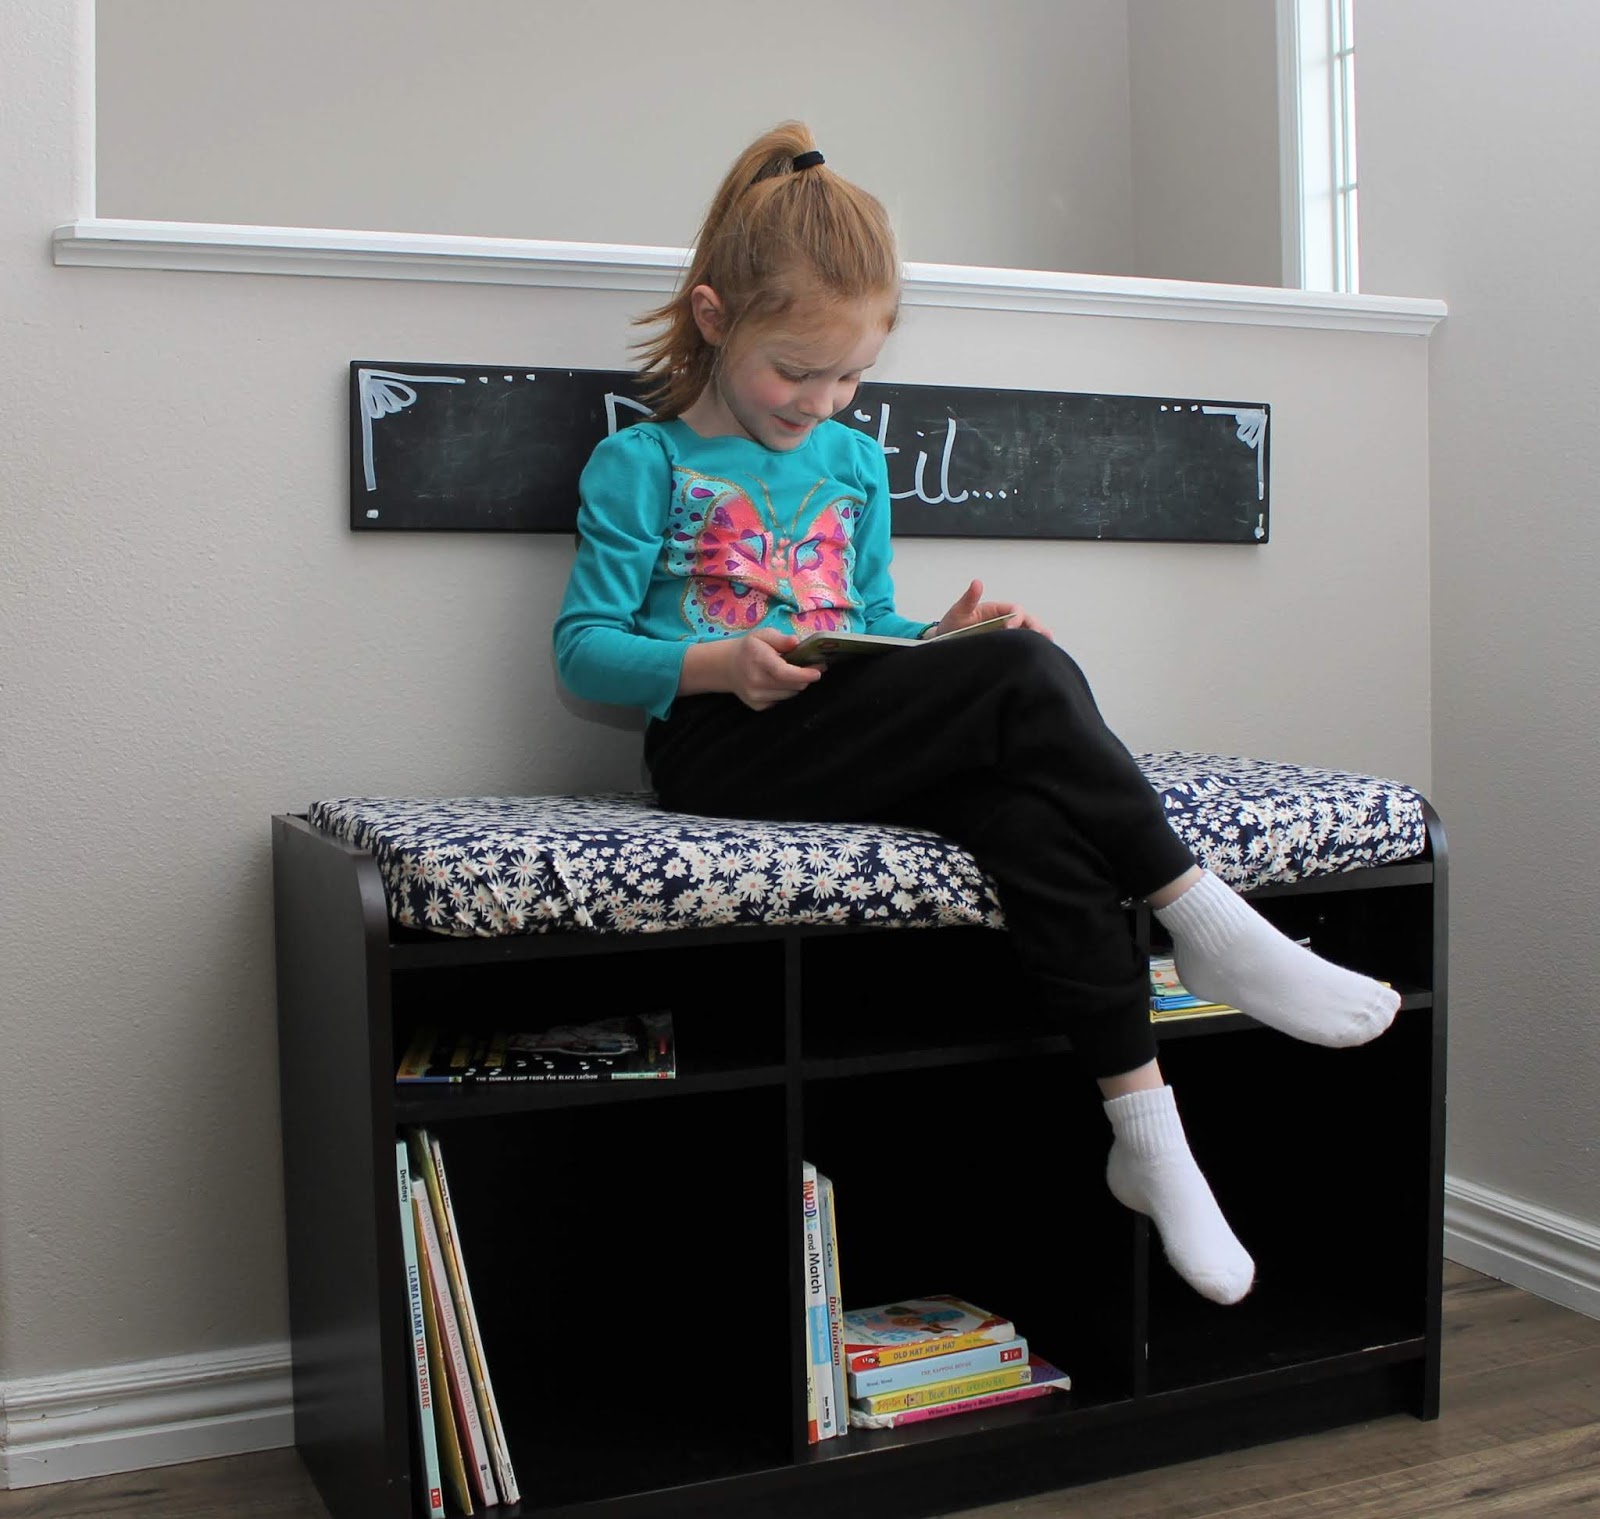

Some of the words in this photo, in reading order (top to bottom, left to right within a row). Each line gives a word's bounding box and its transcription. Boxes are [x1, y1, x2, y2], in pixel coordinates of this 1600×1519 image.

[400, 1169, 409, 1203] Dewdney
[807, 1233, 816, 1251] and
[408, 1265, 420, 1299] LLAMA
[809, 1253, 822, 1294] Match
[412, 1301, 424, 1336] LLAMA
[416, 1337, 427, 1361] TIME
[831, 1322, 840, 1366] Hudson
[893, 1350, 907, 1359] OLD
[909, 1347, 923, 1357] HAT
[924, 1344, 941, 1354] NEW
[943, 1341, 956, 1351] HAT
[418, 1363, 427, 1376] TO
[420, 1378, 431, 1410] SHARE
